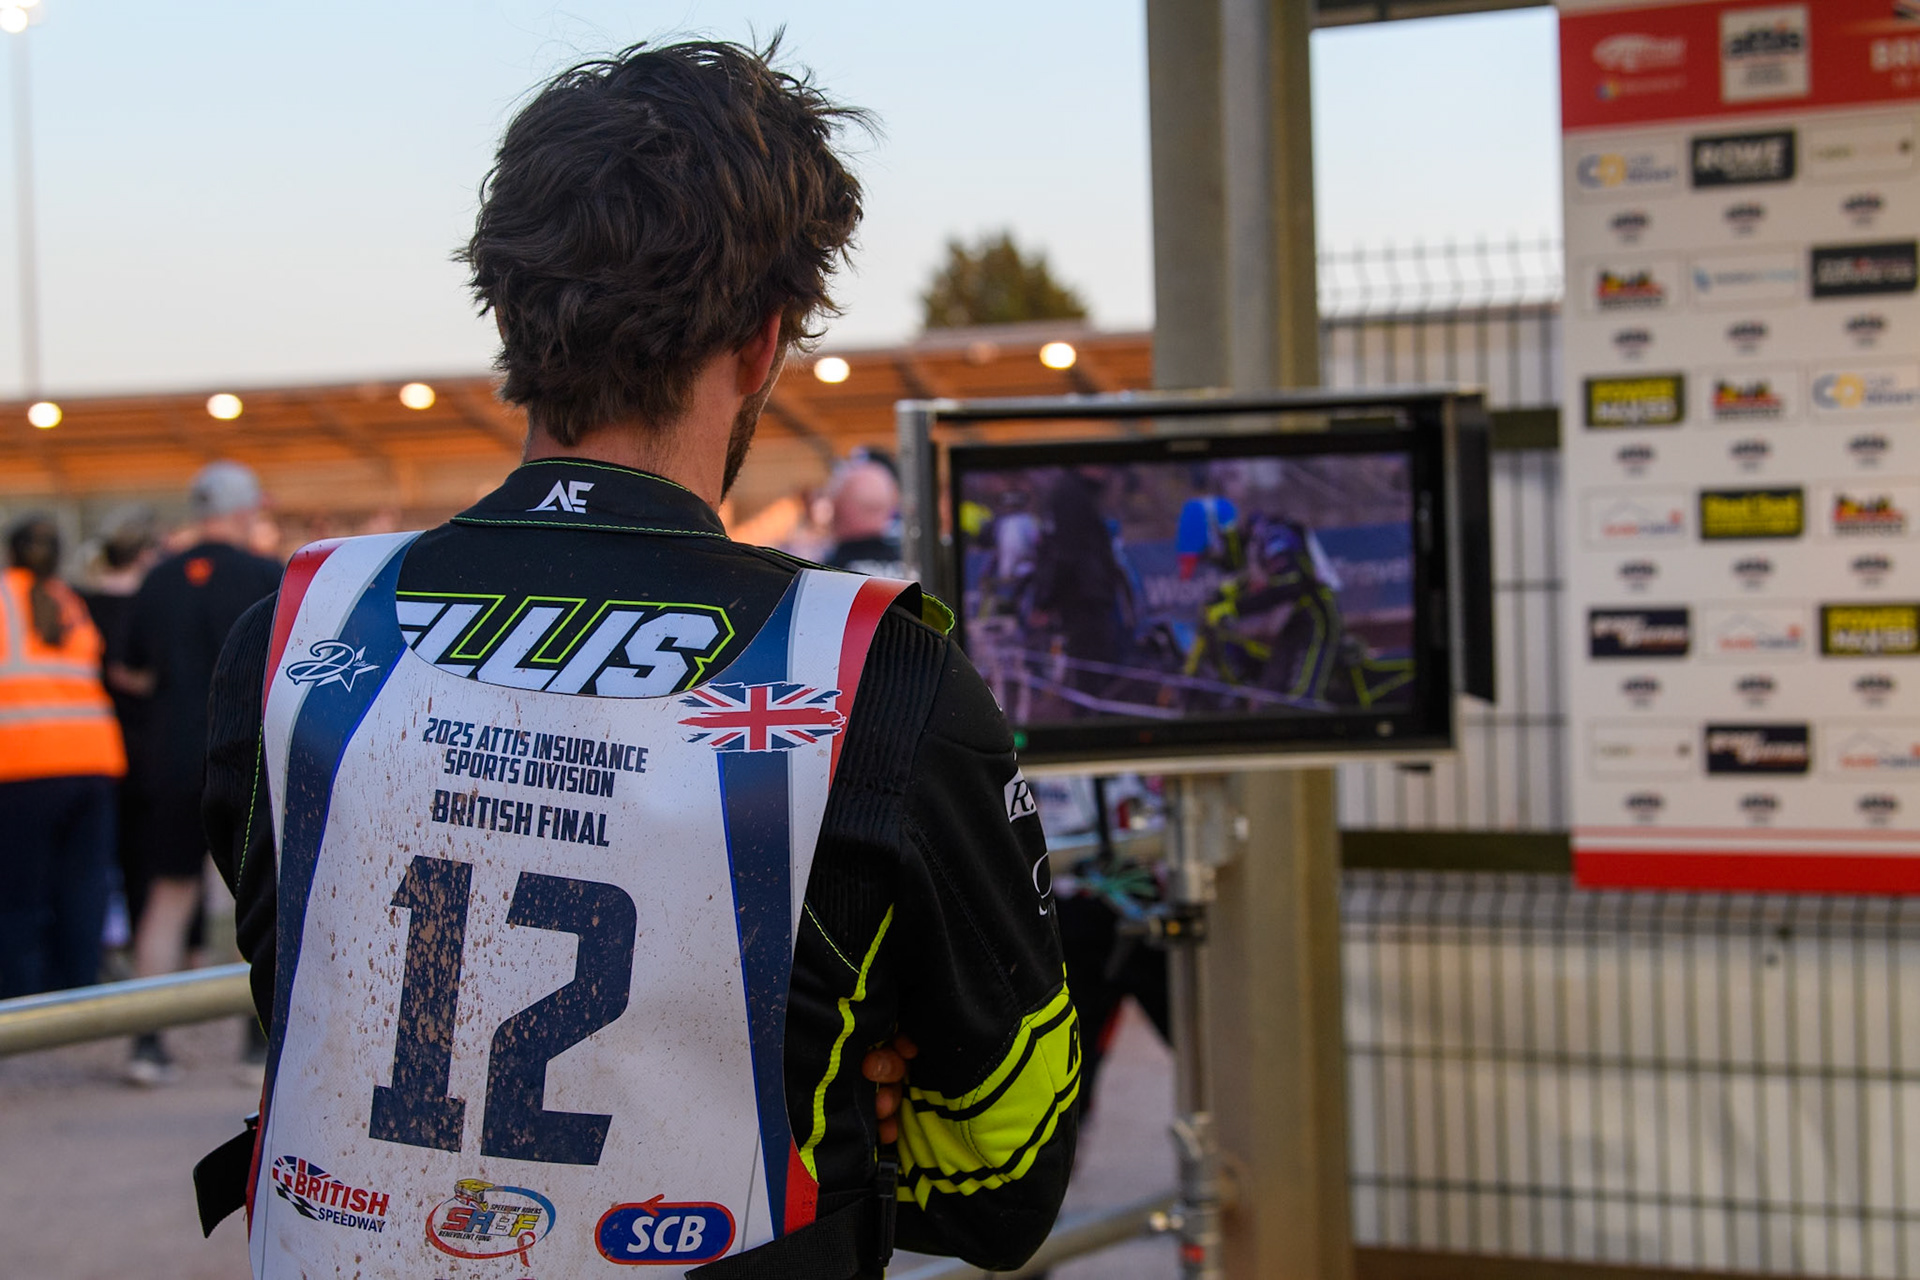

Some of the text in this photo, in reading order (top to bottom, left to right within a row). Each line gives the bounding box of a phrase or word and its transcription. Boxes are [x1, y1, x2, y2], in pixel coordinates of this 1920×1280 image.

[422, 717, 649, 774] 2025 ATTIS INSURANCE
[443, 748, 616, 798] SPORTS DIVISION
[431, 789, 611, 847] BRITISH FINAL
[368, 855, 637, 1165] 12
[294, 1171, 390, 1217] BRITISH
[521, 1206, 543, 1214] RIDERS
[317, 1207, 386, 1233] SPEEDWAY
[438, 1230, 474, 1241] BENEVOLENT
[626, 1215, 707, 1253] SCB
